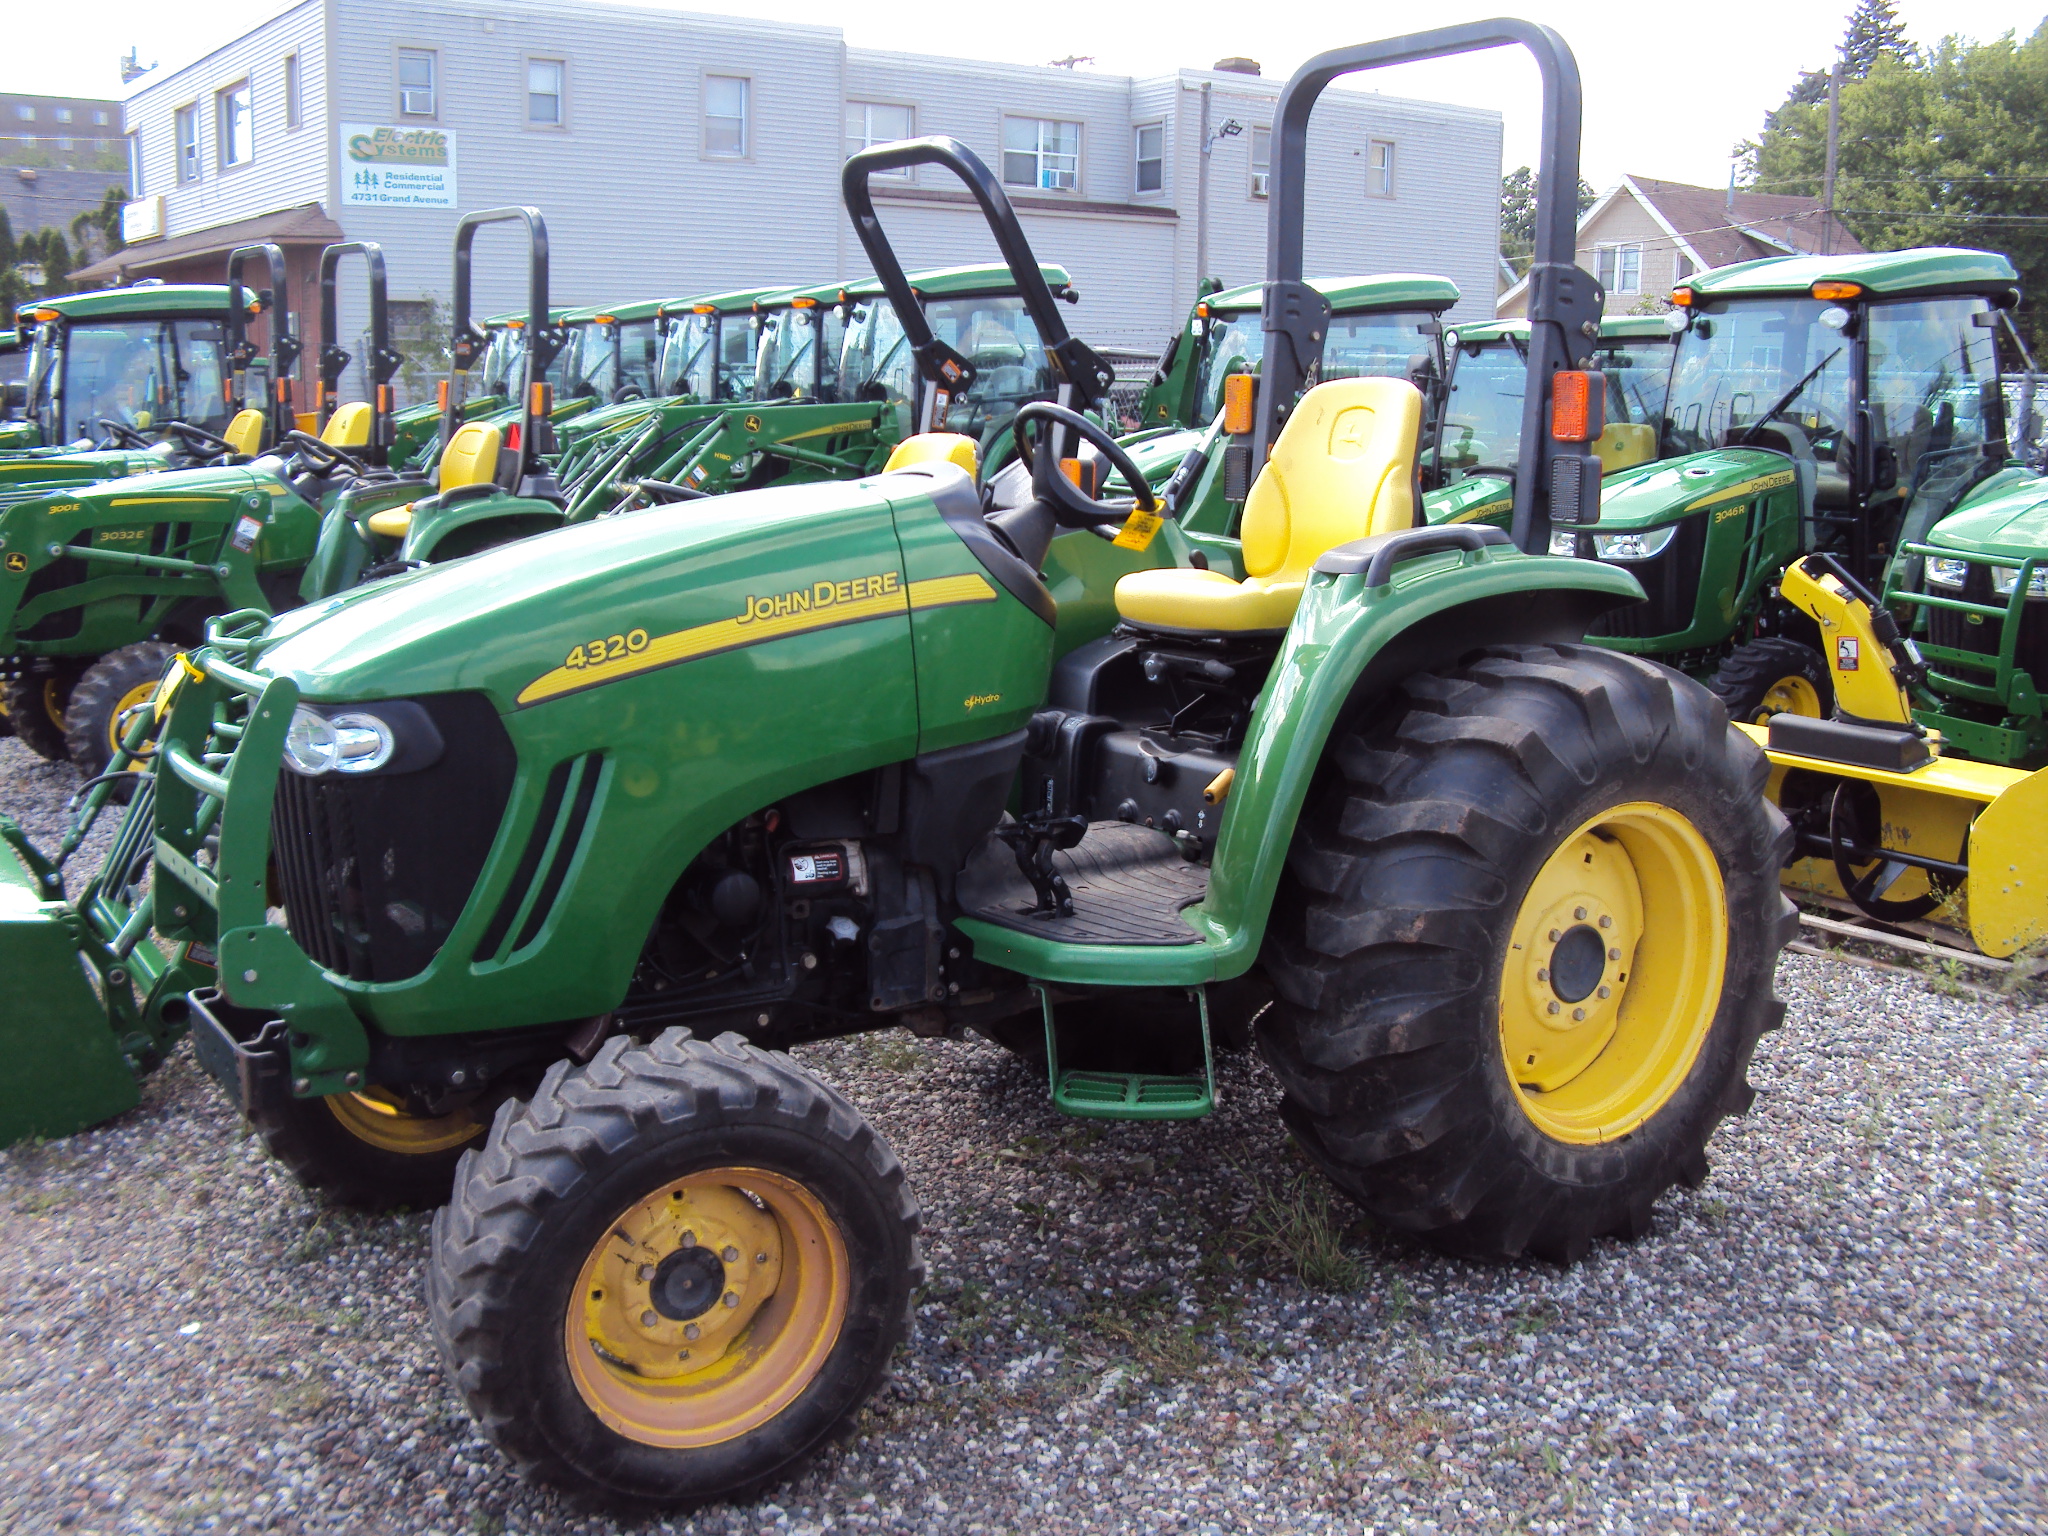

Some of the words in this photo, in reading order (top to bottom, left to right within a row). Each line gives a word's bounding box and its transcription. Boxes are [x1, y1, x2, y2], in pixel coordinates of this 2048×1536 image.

[373, 128, 447, 146] Electric
[349, 134, 447, 161] Systems
[384, 181, 445, 191] Commercial
[385, 172, 443, 182] Residential
[351, 192, 378, 202] 4731
[379, 193, 411, 203] Grand
[413, 195, 449, 205] Avenue
[1749, 481, 1769, 493] JOHN
[1769, 475, 1791, 487] DEERE
[1475, 507, 1492, 518] JOHN
[1492, 502, 1511, 513] DEERE
[1715, 505, 1745, 523] 3046R
[100, 530, 145, 541] 3032E
[737, 587, 811, 624] JOHN
[813, 571, 899, 608] DEERE
[565, 628, 650, 669] 4320
